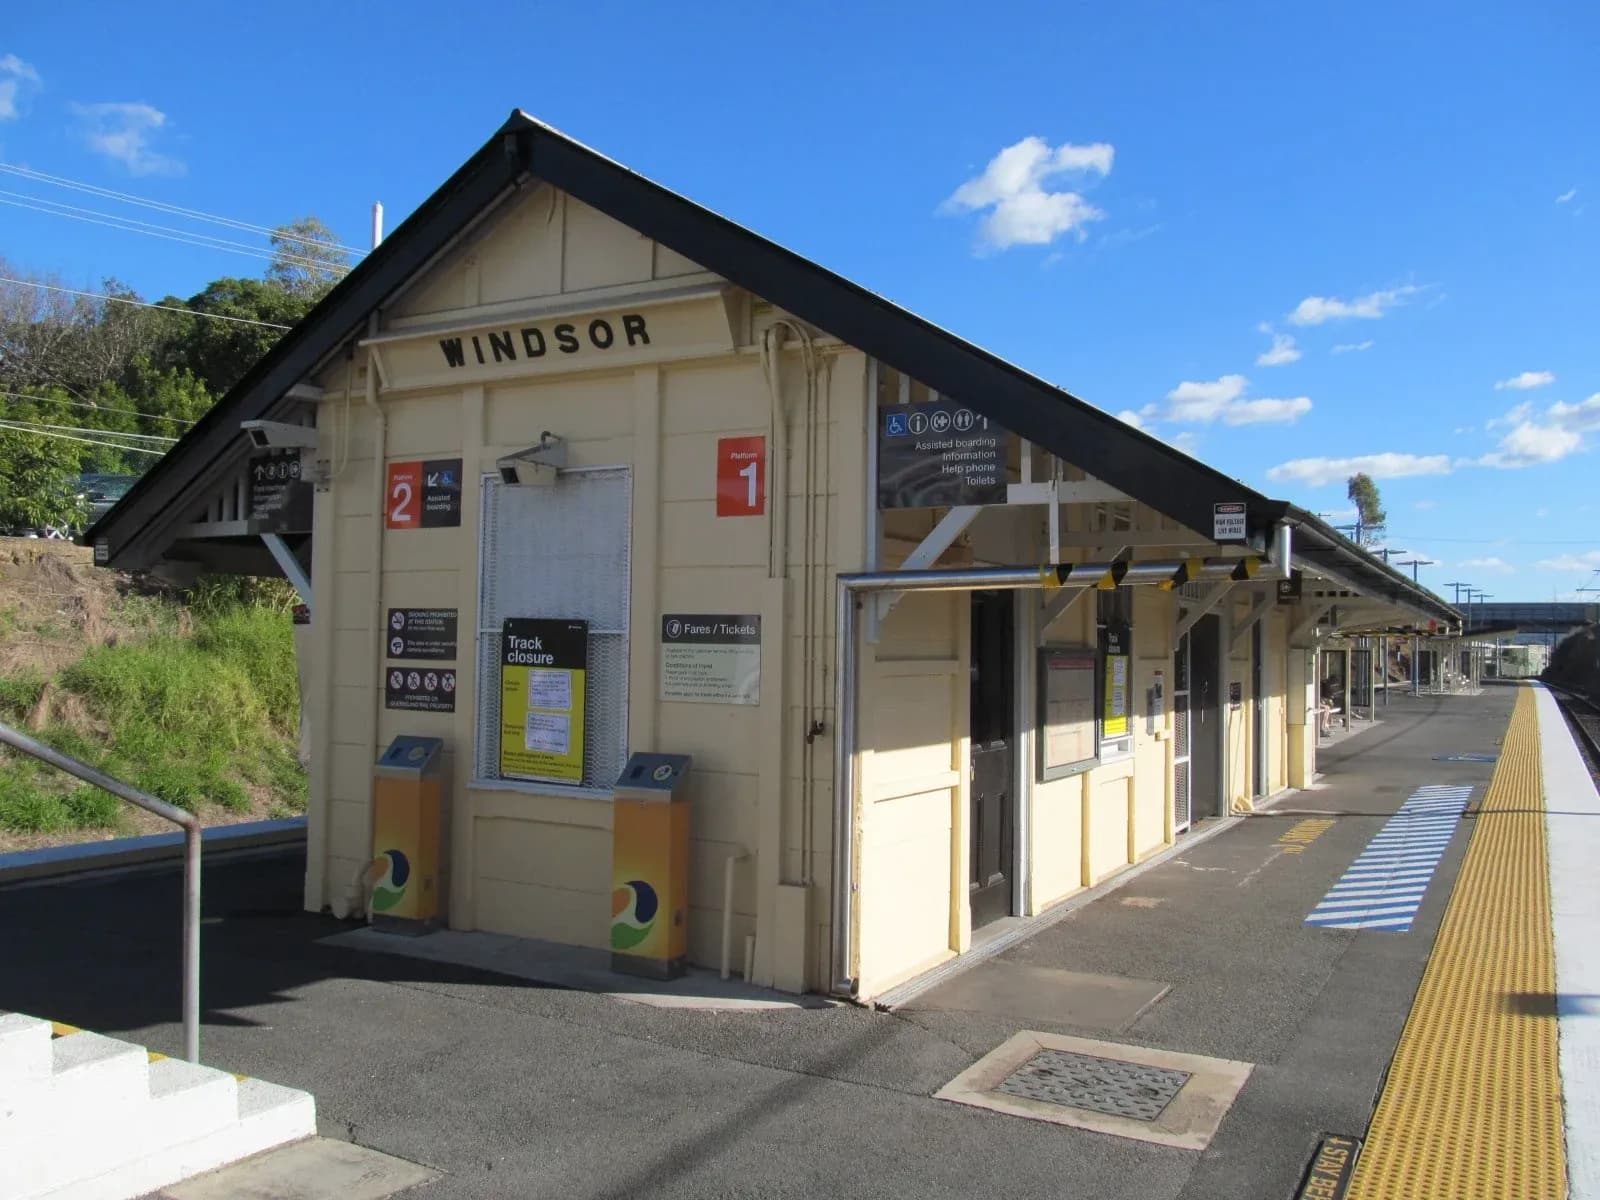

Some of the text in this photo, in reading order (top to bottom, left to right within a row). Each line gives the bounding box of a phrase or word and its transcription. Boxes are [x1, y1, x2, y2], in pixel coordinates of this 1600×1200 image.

[440, 314, 651, 368] WINDSOR
[915, 437, 996, 451] Assisted boarding
[730, 452, 758, 460] Platform
[943, 449, 996, 462] Information
[942, 462, 996, 475] Help phone
[739, 462, 757, 507] 1
[965, 475, 996, 486] Toilets
[392, 482, 412, 522] 2
[684, 623, 756, 636] Fares / Tickets
[508, 635, 543, 650] Track
[507, 649, 554, 665] closure
[1314, 1146, 1349, 1178] STAY
